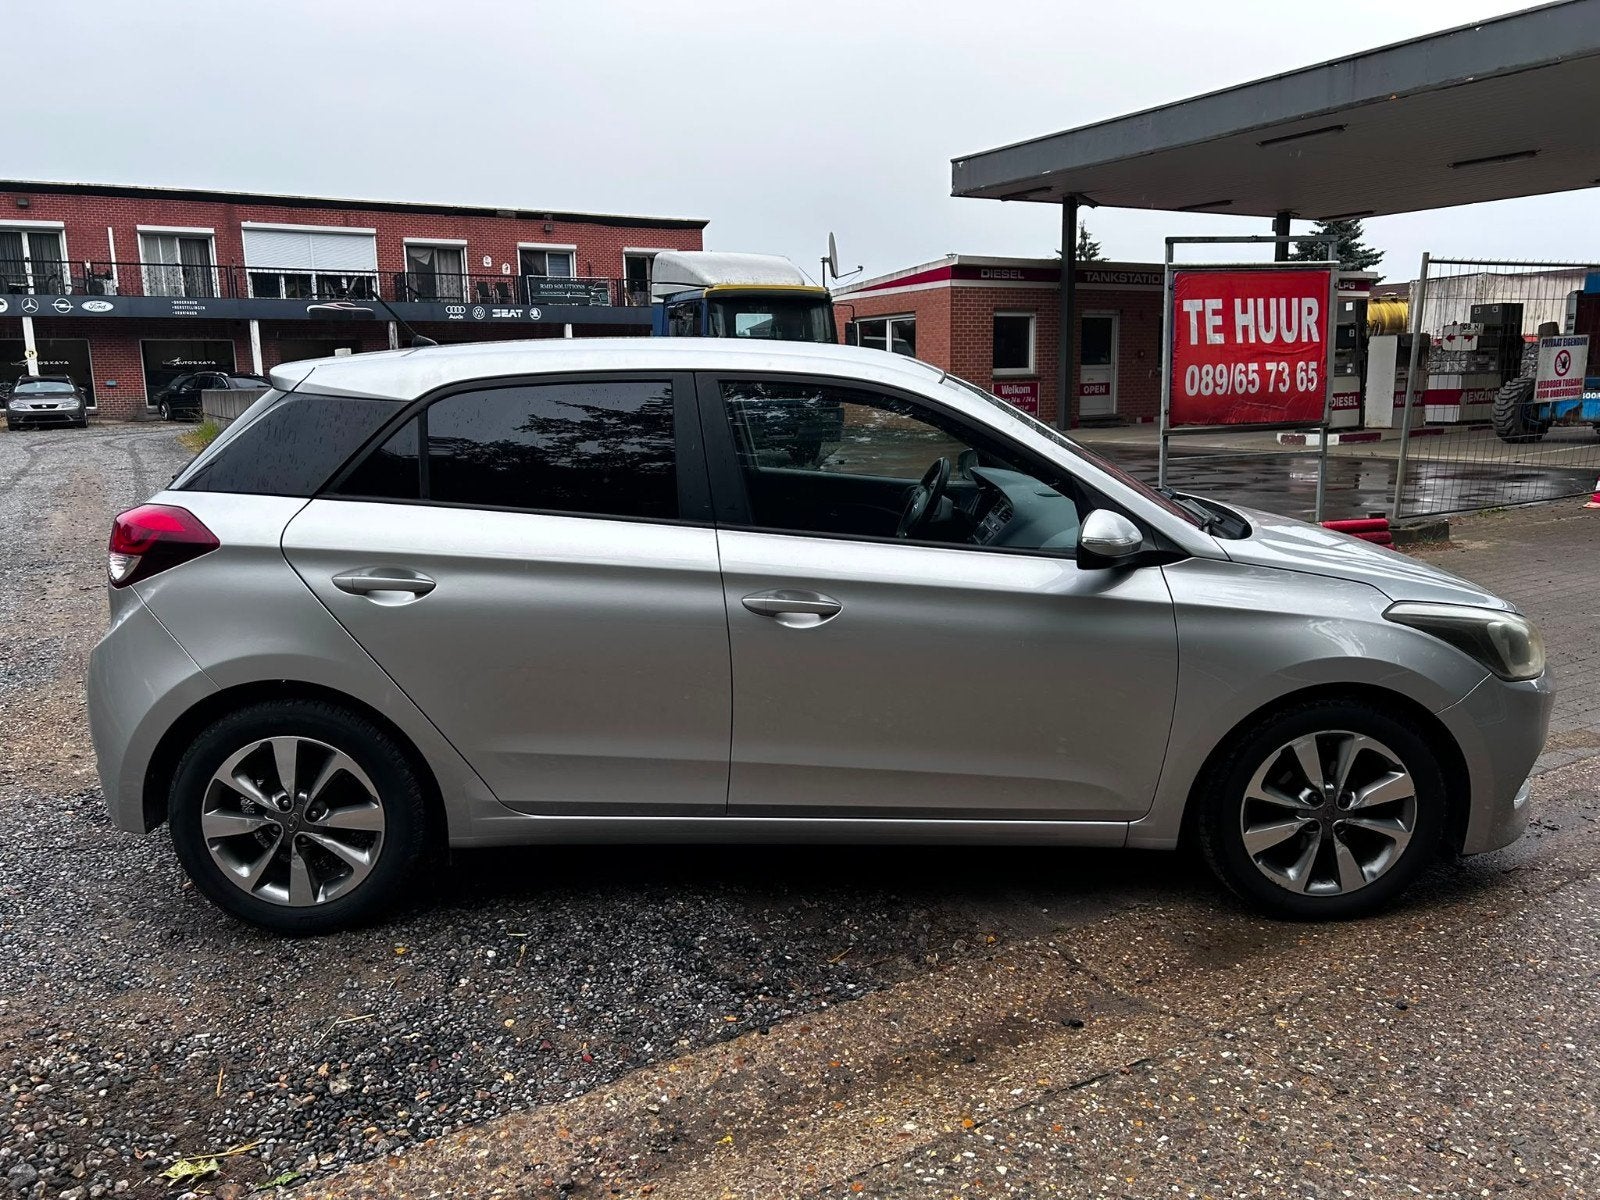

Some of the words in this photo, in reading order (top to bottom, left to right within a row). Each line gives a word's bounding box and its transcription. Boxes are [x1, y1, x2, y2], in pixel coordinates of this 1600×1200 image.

[980, 268, 1024, 279] DIESEL
[1085, 271, 1164, 284] TANKSTATIO
[1338, 281, 1356, 290] LPG
[492, 308, 523, 318] SEAT
[1182, 298, 1225, 346] TE
[1234, 297, 1321, 345] HUUR
[1184, 362, 1260, 397] 089/65
[1265, 361, 1290, 393] 73
[1296, 361, 1318, 392] 65
[1001, 384, 1031, 395] Welkom
[1083, 385, 1106, 395] OPEN
